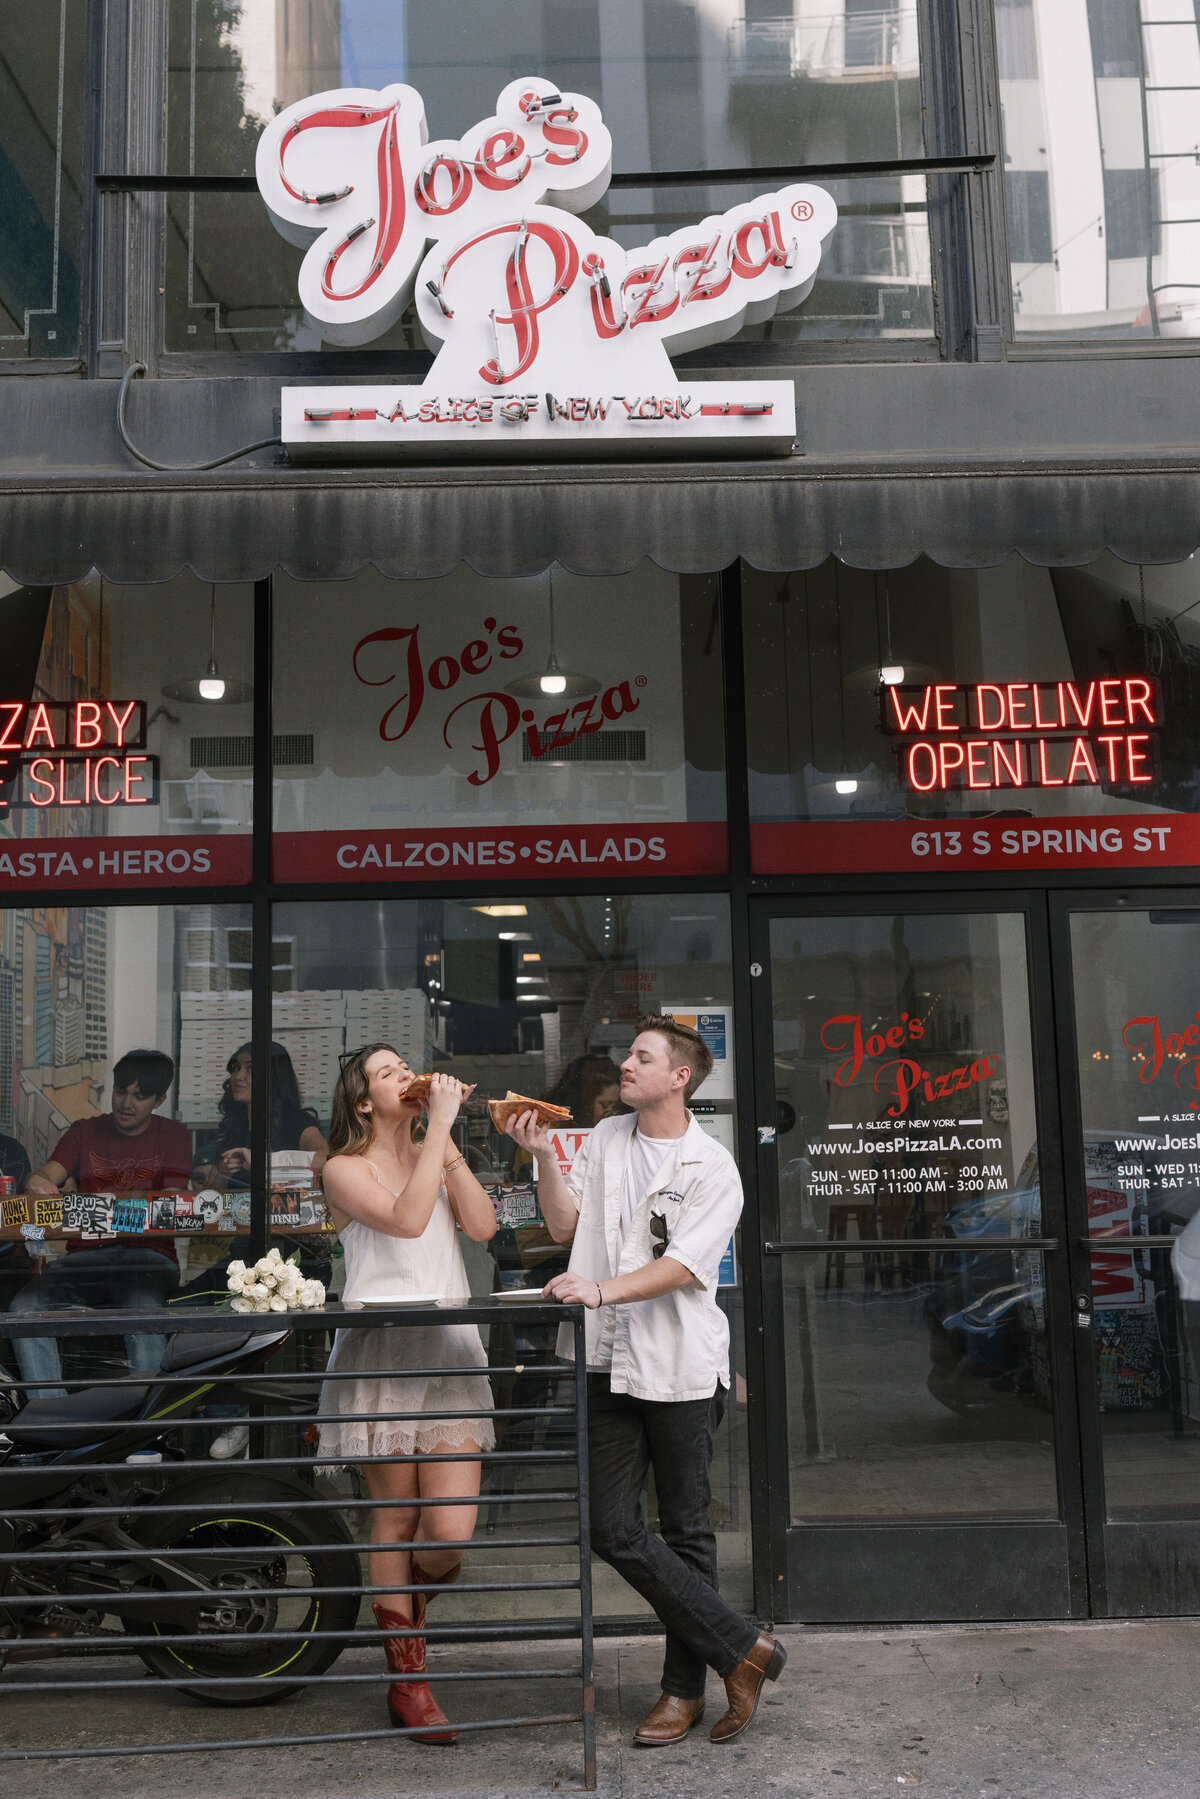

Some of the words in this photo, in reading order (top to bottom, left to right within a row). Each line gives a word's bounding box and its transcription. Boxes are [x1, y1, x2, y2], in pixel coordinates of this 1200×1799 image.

[278, 85, 588, 302] Joe's
[439, 211, 797, 385] Pizza
[389, 399, 408, 422] A
[418, 396, 494, 422] SLICE
[500, 393, 538, 422] OF
[546, 393, 610, 422] NEW
[622, 396, 692, 420] YORK
[352, 616, 525, 742] Joe's
[889, 684, 961, 732] WE
[976, 678, 1156, 731] DELIVER
[76, 702, 136, 749] BY
[443, 678, 641, 787] Pizza
[908, 739, 1024, 792] OPEN
[1038, 734, 1154, 786] LATE
[28, 756, 148, 807] SLICE
[911, 830, 962, 856] 613
[972, 830, 992, 856] S
[1001, 826, 1124, 856] SPRING
[1133, 826, 1172, 852] ST
[820, 1012, 926, 1087] Joe's
[873, 1055, 995, 1118] Pizza
[856, 1122, 863, 1130] A
[866, 1120, 892, 1130] SLICE
[894, 1120, 906, 1129] OF
[909, 1120, 930, 1129] NEW
[933, 1118, 957, 1128] YORK
[1163, 1114, 1170, 1122] A
[1172, 1113, 1196, 1122] SLICE
[808, 1135, 1002, 1156] www.JoesPizzaLA.com
[811, 1170, 838, 1183] SUN
[849, 1169, 879, 1182] WED
[882, 1168, 916, 1181] 11:00
[919, 1167, 941, 1179] AM
[981, 1165, 1002, 1177] AM
[1118, 1165, 1143, 1176] SUN
[1155, 1164, 1185, 1175] WED
[1118, 1178, 1150, 1190] THUR
[1161, 1177, 1184, 1188] SAT
[807, 1183, 843, 1196] THUR
[853, 1182, 877, 1195] SAT
[888, 1181, 922, 1194] 11:00
[925, 1180, 946, 1192] AM
[957, 1179, 984, 1192] 3:00
[987, 1178, 1008, 1190] AM
[3, 1197, 27, 1217] HONEY
[5, 1213, 28, 1226] ONE
